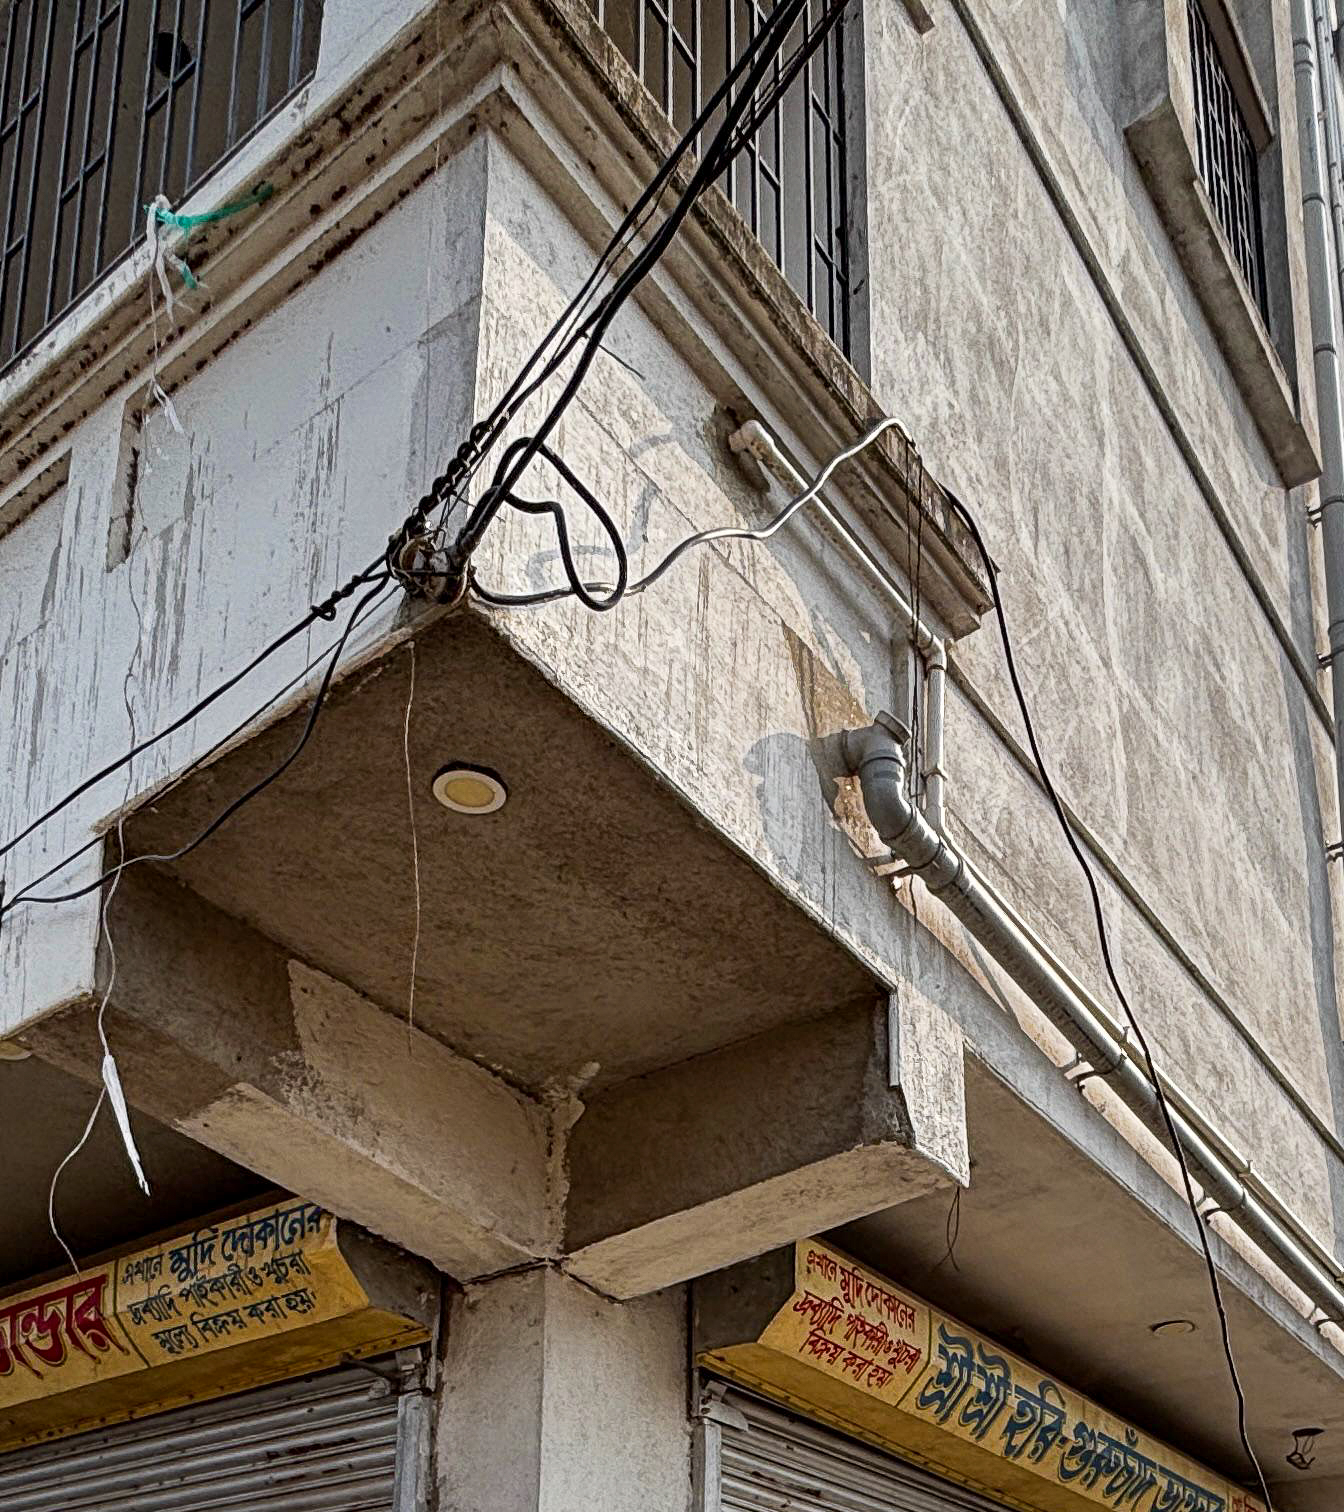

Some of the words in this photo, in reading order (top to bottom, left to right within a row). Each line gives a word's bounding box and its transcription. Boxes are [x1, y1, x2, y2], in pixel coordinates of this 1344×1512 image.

[121, 1253, 163, 1286] এখানে
[248, 1265, 264, 1287] ও
[806, 1249, 838, 1282] এখানে
[839, 1266, 865, 1309] মুদি
[865, 1280, 916, 1334] দোকানের
[242, 1295, 288, 1325] করা
[842, 1350, 875, 1382] করা
[916, 1322, 976, 1425] শ্রী
[959, 1342, 1013, 1442] শ্রী
